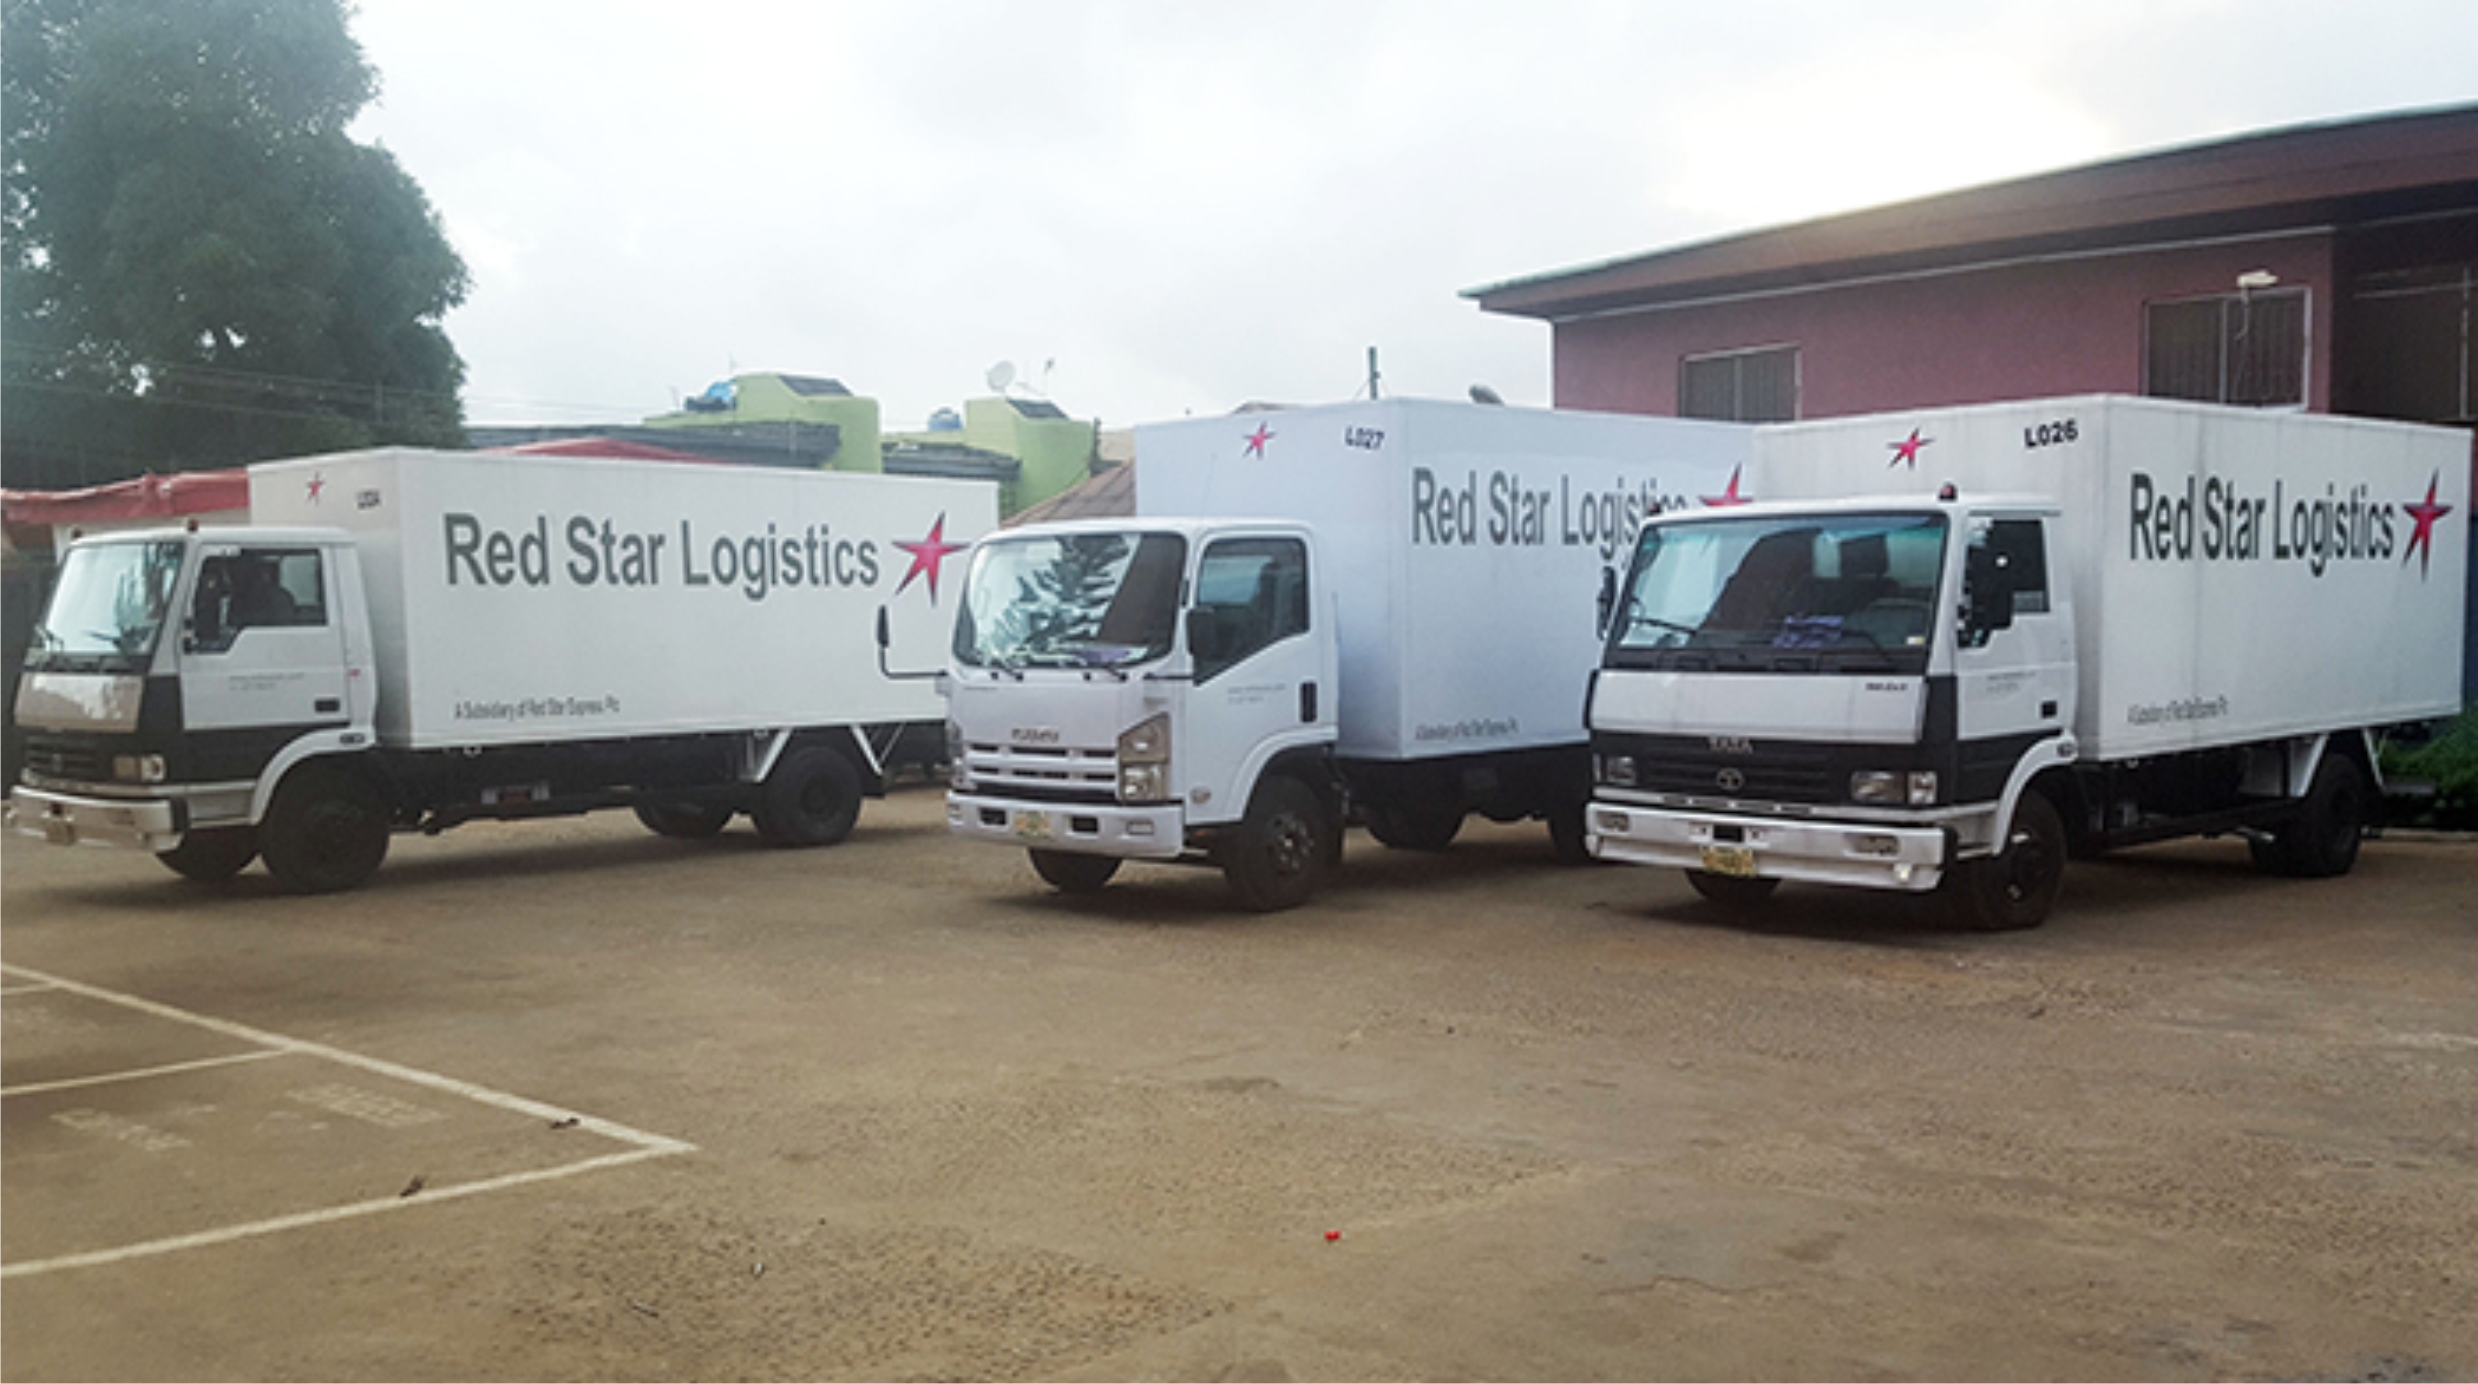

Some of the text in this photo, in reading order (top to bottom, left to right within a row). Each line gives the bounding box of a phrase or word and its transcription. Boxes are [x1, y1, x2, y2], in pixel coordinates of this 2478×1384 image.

[1345, 426, 1384, 450] L027
[2024, 418, 2078, 448] L026
[444, 513, 879, 600] Red Star Logistics
[1413, 467, 1688, 562] Red Star Logist
[2131, 474, 2394, 577] Red Star Logistics
